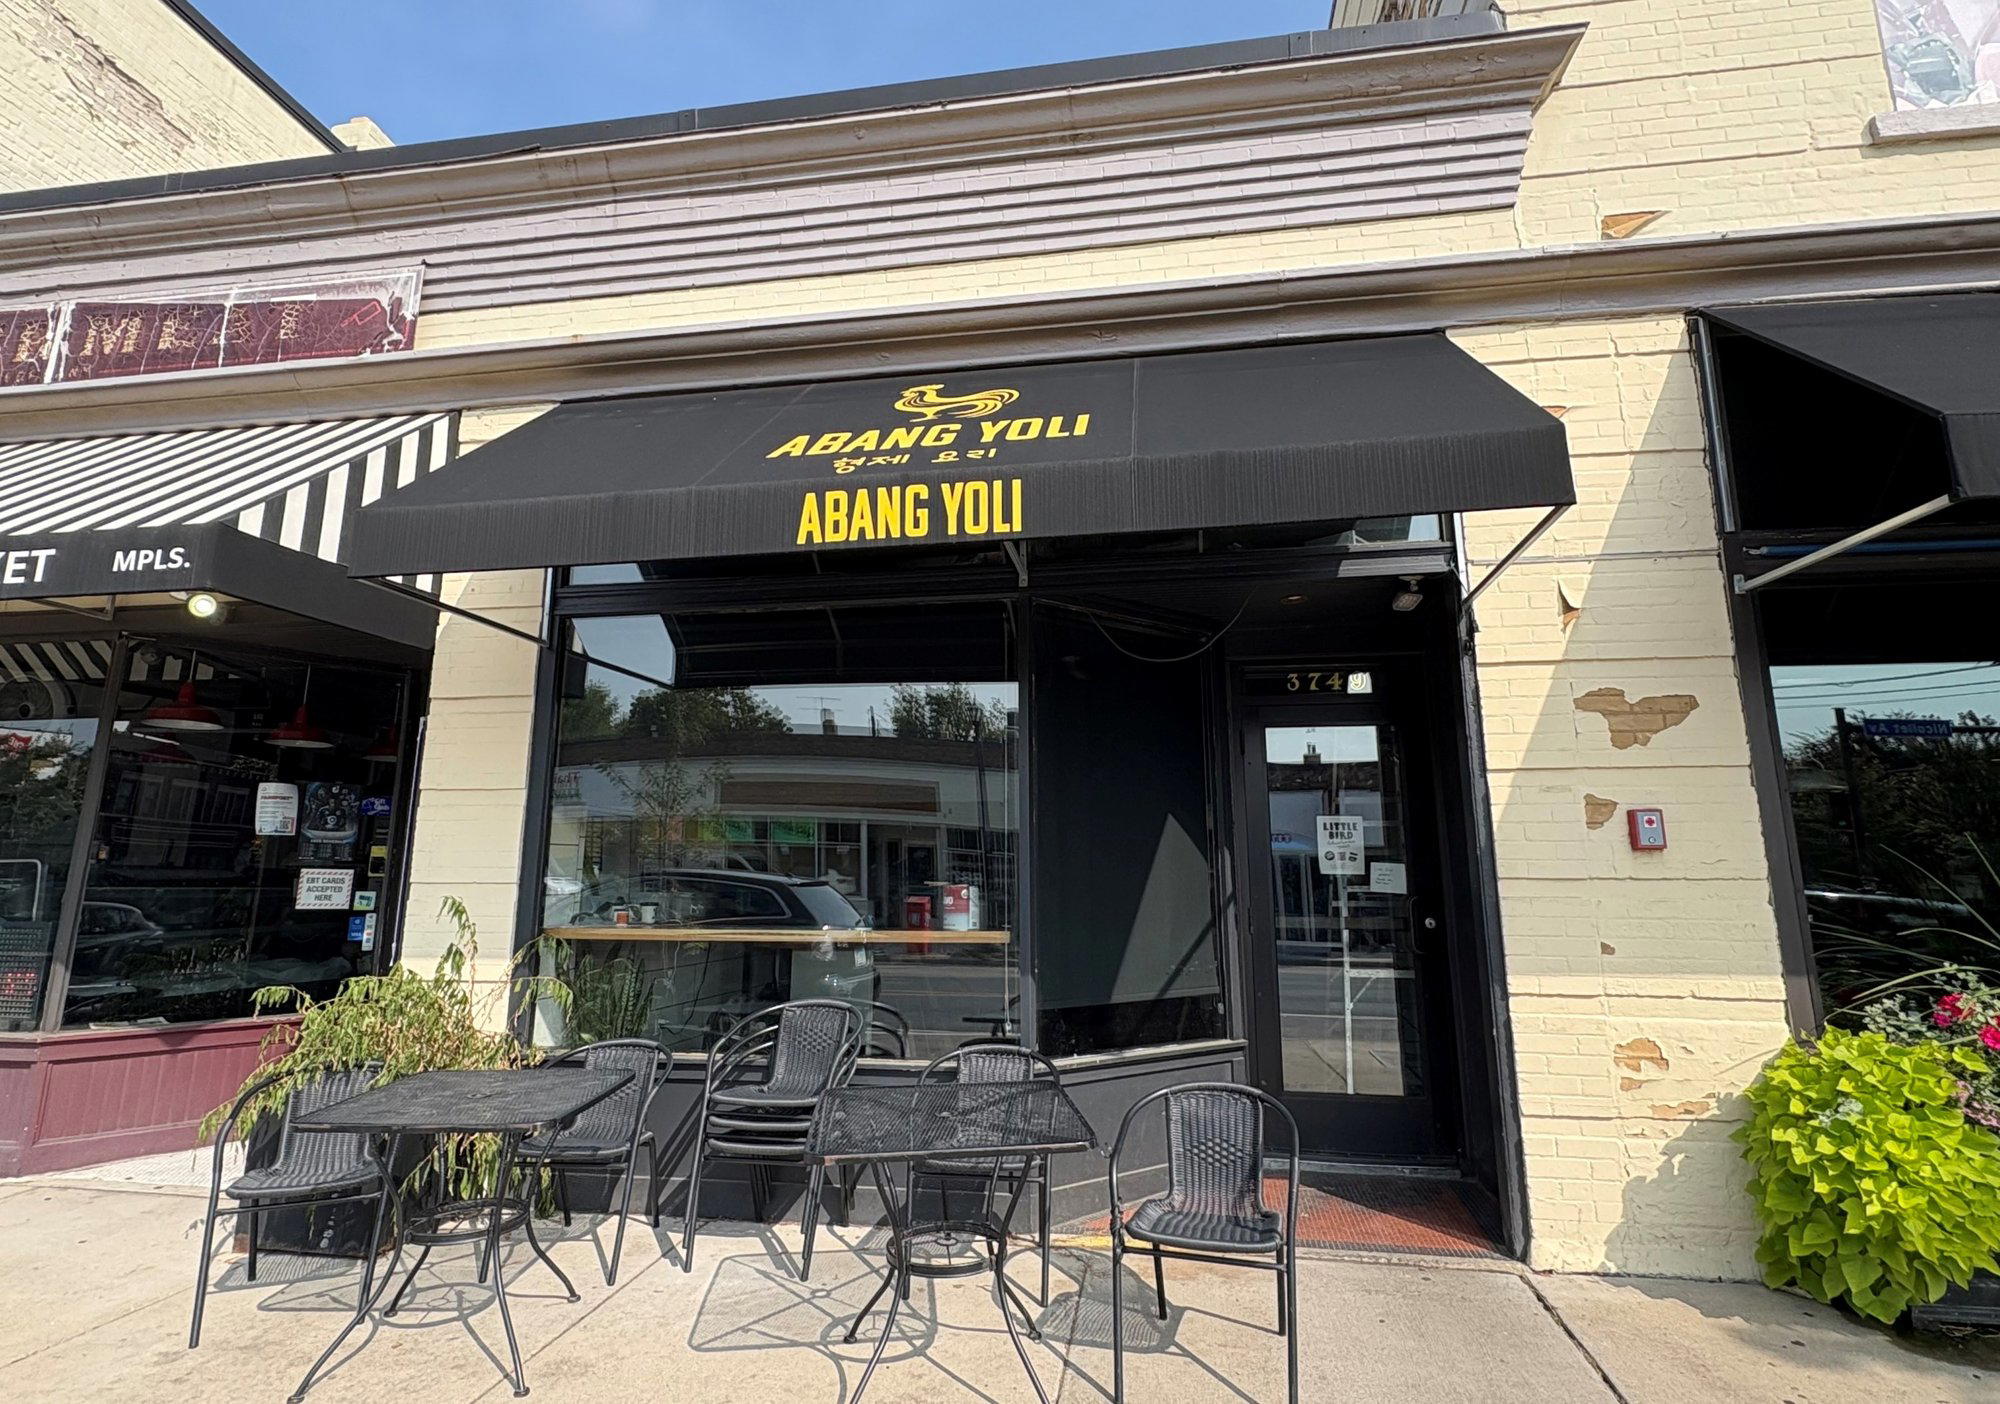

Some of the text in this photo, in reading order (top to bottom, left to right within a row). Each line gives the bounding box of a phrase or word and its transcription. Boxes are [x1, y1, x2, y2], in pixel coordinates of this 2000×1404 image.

[765, 413, 1091, 459] ABANG YOLI
[833, 448, 997, 474] 형제 요리
[796, 479, 1022, 544] ABANG YOLI
[0, 547, 191, 584] ET MPLS.
[1323, 822, 1358, 830] LITTLE
